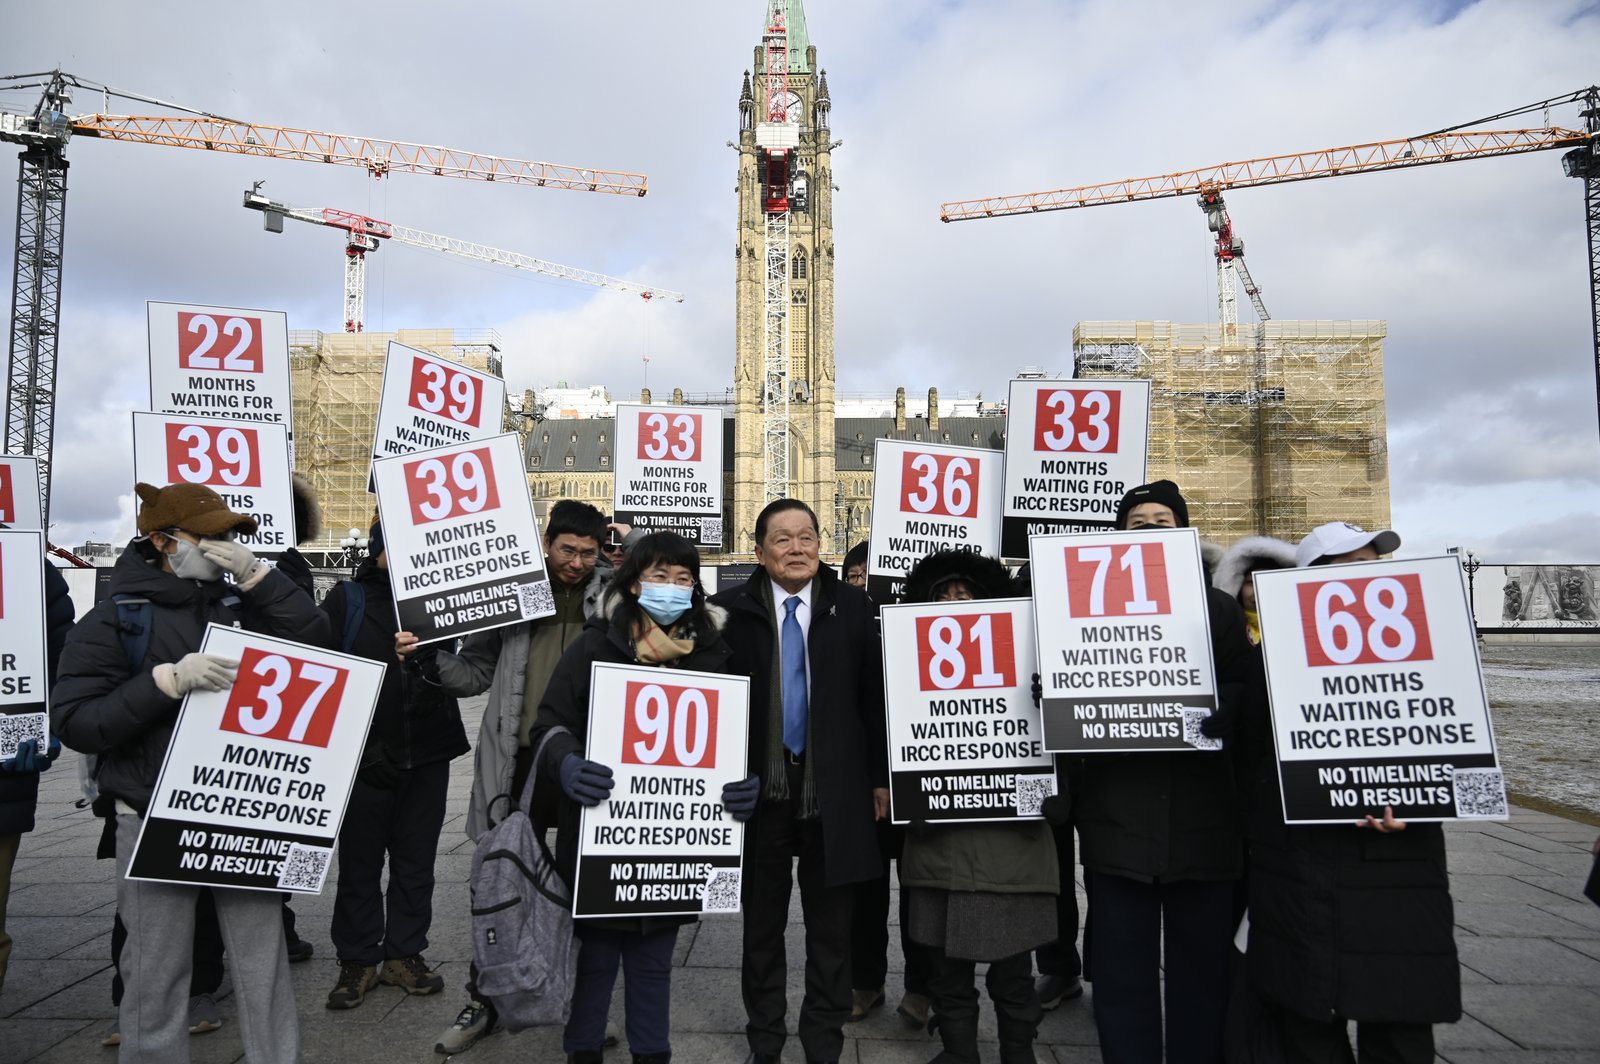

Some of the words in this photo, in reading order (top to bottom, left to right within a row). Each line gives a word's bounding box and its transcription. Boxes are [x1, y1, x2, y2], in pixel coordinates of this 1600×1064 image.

[188, 314, 255, 371] 22
[188, 376, 255, 392] MONTHS
[418, 363, 475, 422] 39
[171, 393, 239, 408] WAITING
[244, 396, 273, 409] FOR
[413, 415, 470, 441] MONTHS
[1043, 390, 1110, 452] 33
[396, 426, 452, 448] WAITIN
[644, 414, 696, 460] 33
[177, 425, 251, 485] 39
[643, 467, 694, 478] MONTHS
[1041, 460, 1108, 476] MONTHS
[415, 452, 490, 521] 39
[630, 480, 680, 492] WAITING
[684, 482, 707, 493] FOR
[908, 454, 972, 516] 36
[1024, 478, 1088, 494] WAITING
[1094, 480, 1124, 495] FOR
[221, 494, 254, 508] THS
[622, 495, 648, 505] IRCC
[650, 496, 714, 507] RESPONSE
[1013, 496, 1046, 510] IRCC
[1050, 498, 1121, 514] RESPONS
[633, 516, 647, 525] NO
[650, 516, 701, 526] TIMELINES
[906, 521, 967, 539] MONTHS
[1027, 523, 1045, 534] NO
[425, 519, 496, 546] MONTHS
[410, 542, 482, 569] WAITING
[486, 534, 518, 553] FOR
[403, 570, 441, 591] IRCC
[443, 550, 532, 582] RESPONSE
[878, 555, 910, 570] IRCC
[1077, 544, 1158, 615] 71
[425, 598, 445, 614] NO
[447, 581, 519, 608] TIMELINES
[434, 613, 454, 628] NO
[457, 599, 517, 623] RESULTS
[1314, 577, 1416, 664] 68
[1081, 625, 1163, 643] MONTHS
[928, 615, 1004, 689] 81
[1062, 648, 1143, 666] WAITING
[1149, 646, 1187, 664] FOR
[1052, 671, 1095, 688] IRCC
[1098, 669, 1201, 688] RESPONSE
[1322, 671, 1424, 696] MONTHS
[238, 654, 338, 742] 37
[929, 697, 1007, 717] MONTHS
[1073, 704, 1096, 720] NO
[1099, 703, 1183, 719] TIMELINES
[1300, 700, 1400, 723] WAITING
[1408, 697, 1456, 719] FOR
[633, 684, 709, 767] 90
[911, 721, 987, 739] WAITING
[994, 719, 1029, 736] FOR
[1082, 723, 1105, 738] NO
[1108, 722, 1180, 738] RESULTS
[1290, 729, 1342, 750] IRCC
[1346, 723, 1476, 747] RESPONSE
[222, 744, 312, 774] MONTHS
[901, 745, 941, 762] IRCC
[944, 741, 1042, 761] RESPONSE
[192, 765, 282, 795] WAITING
[286, 780, 326, 802] FOR
[921, 777, 942, 791] NO
[944, 774, 1018, 790] TIMELINE
[1318, 767, 1346, 785] NO
[1349, 764, 1454, 784] TIMELINES
[630, 776, 706, 796] MONTHS
[928, 795, 950, 809] NO
[954, 793, 1017, 808] RESULTS
[1329, 789, 1358, 807] NO
[1362, 787, 1450, 806] RESULTS
[168, 789, 219, 813] IRCC
[221, 796, 331, 827] RESPONSE
[608, 801, 685, 820] WAITING
[690, 803, 723, 822] FOR
[179, 830, 207, 847] NO
[210, 833, 300, 856] TIMELINE
[594, 826, 636, 845] IRCC
[639, 827, 732, 846] RESPONSE
[180, 852, 208, 869] NO
[210, 855, 286, 877] RESULTS
[610, 864, 633, 880] NO
[636, 863, 713, 880] TIMELINES
[615, 884, 638, 902] NO
[641, 884, 705, 901] RESULTS
